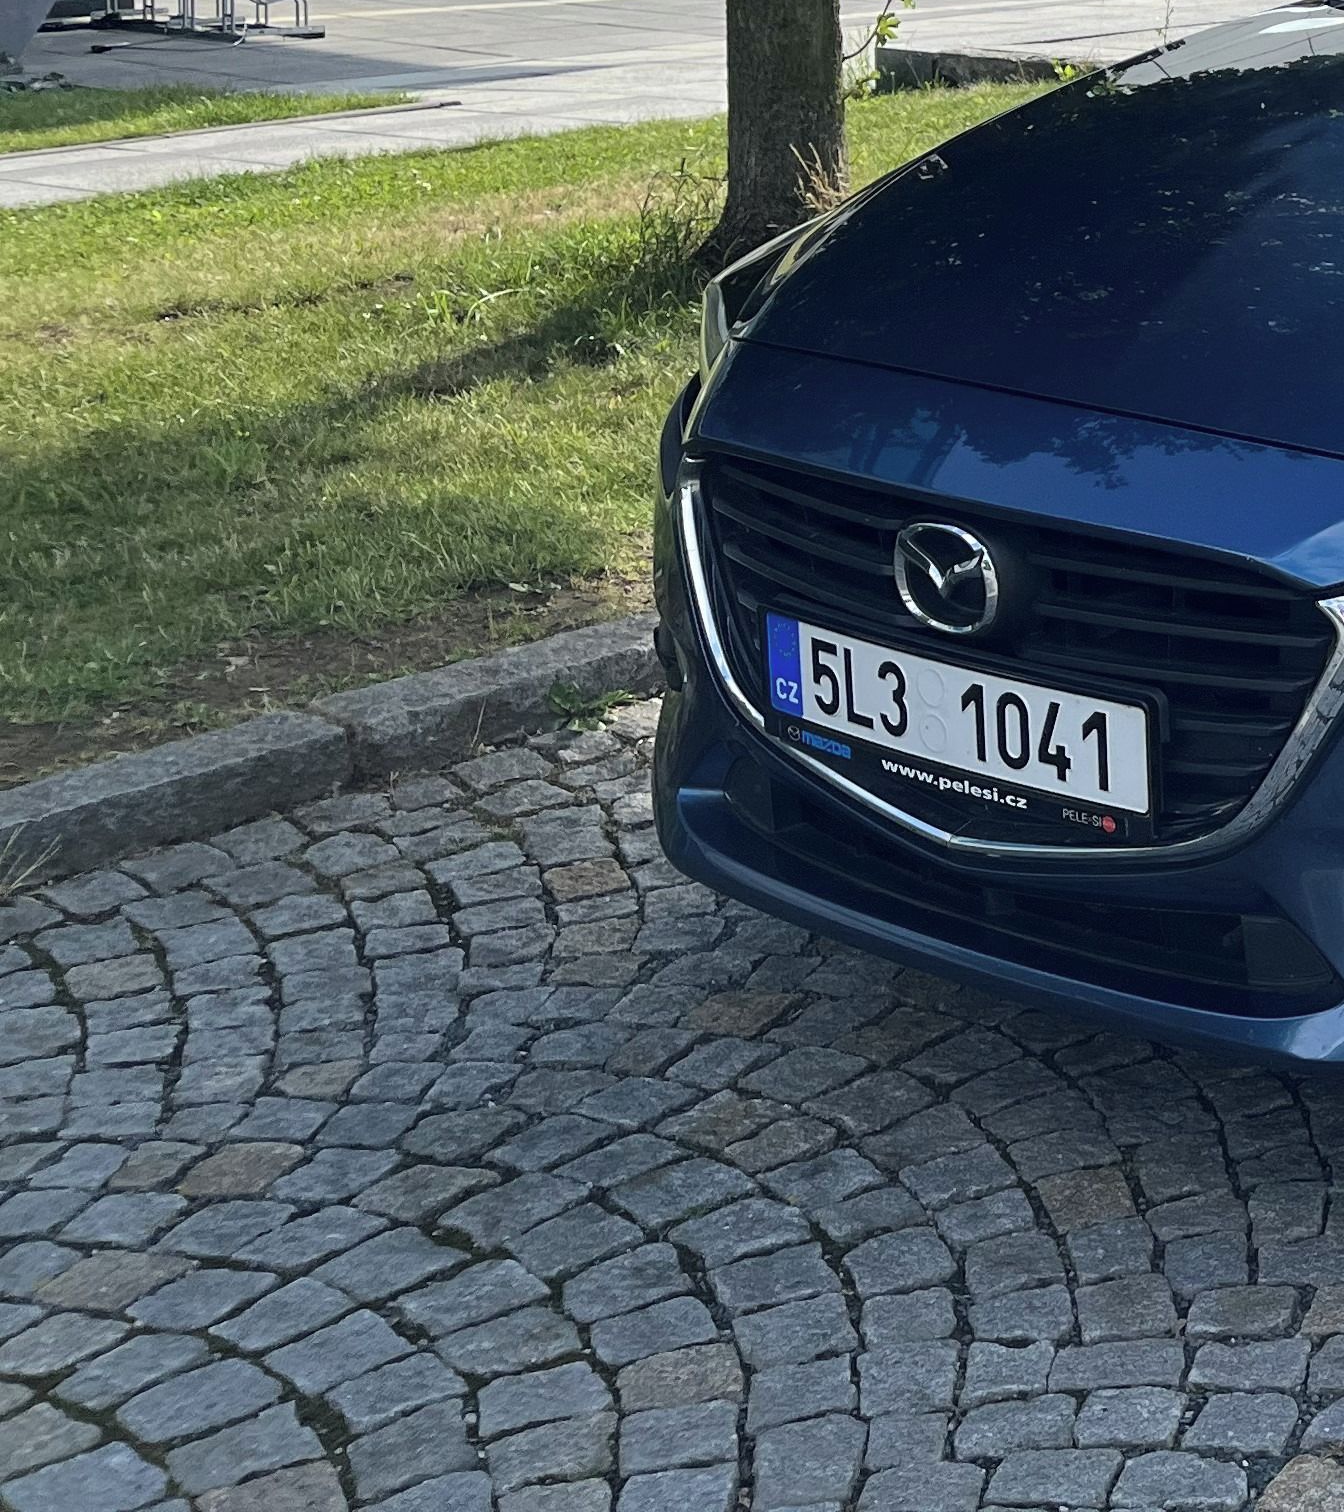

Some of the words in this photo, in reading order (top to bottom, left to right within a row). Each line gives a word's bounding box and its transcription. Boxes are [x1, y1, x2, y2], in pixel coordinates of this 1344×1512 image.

[775, 677, 800, 705] CZ
[810, 636, 908, 738] 5L3
[960, 682, 1111, 792] 1041
[881, 757, 1028, 809] www.pelesi.cz
